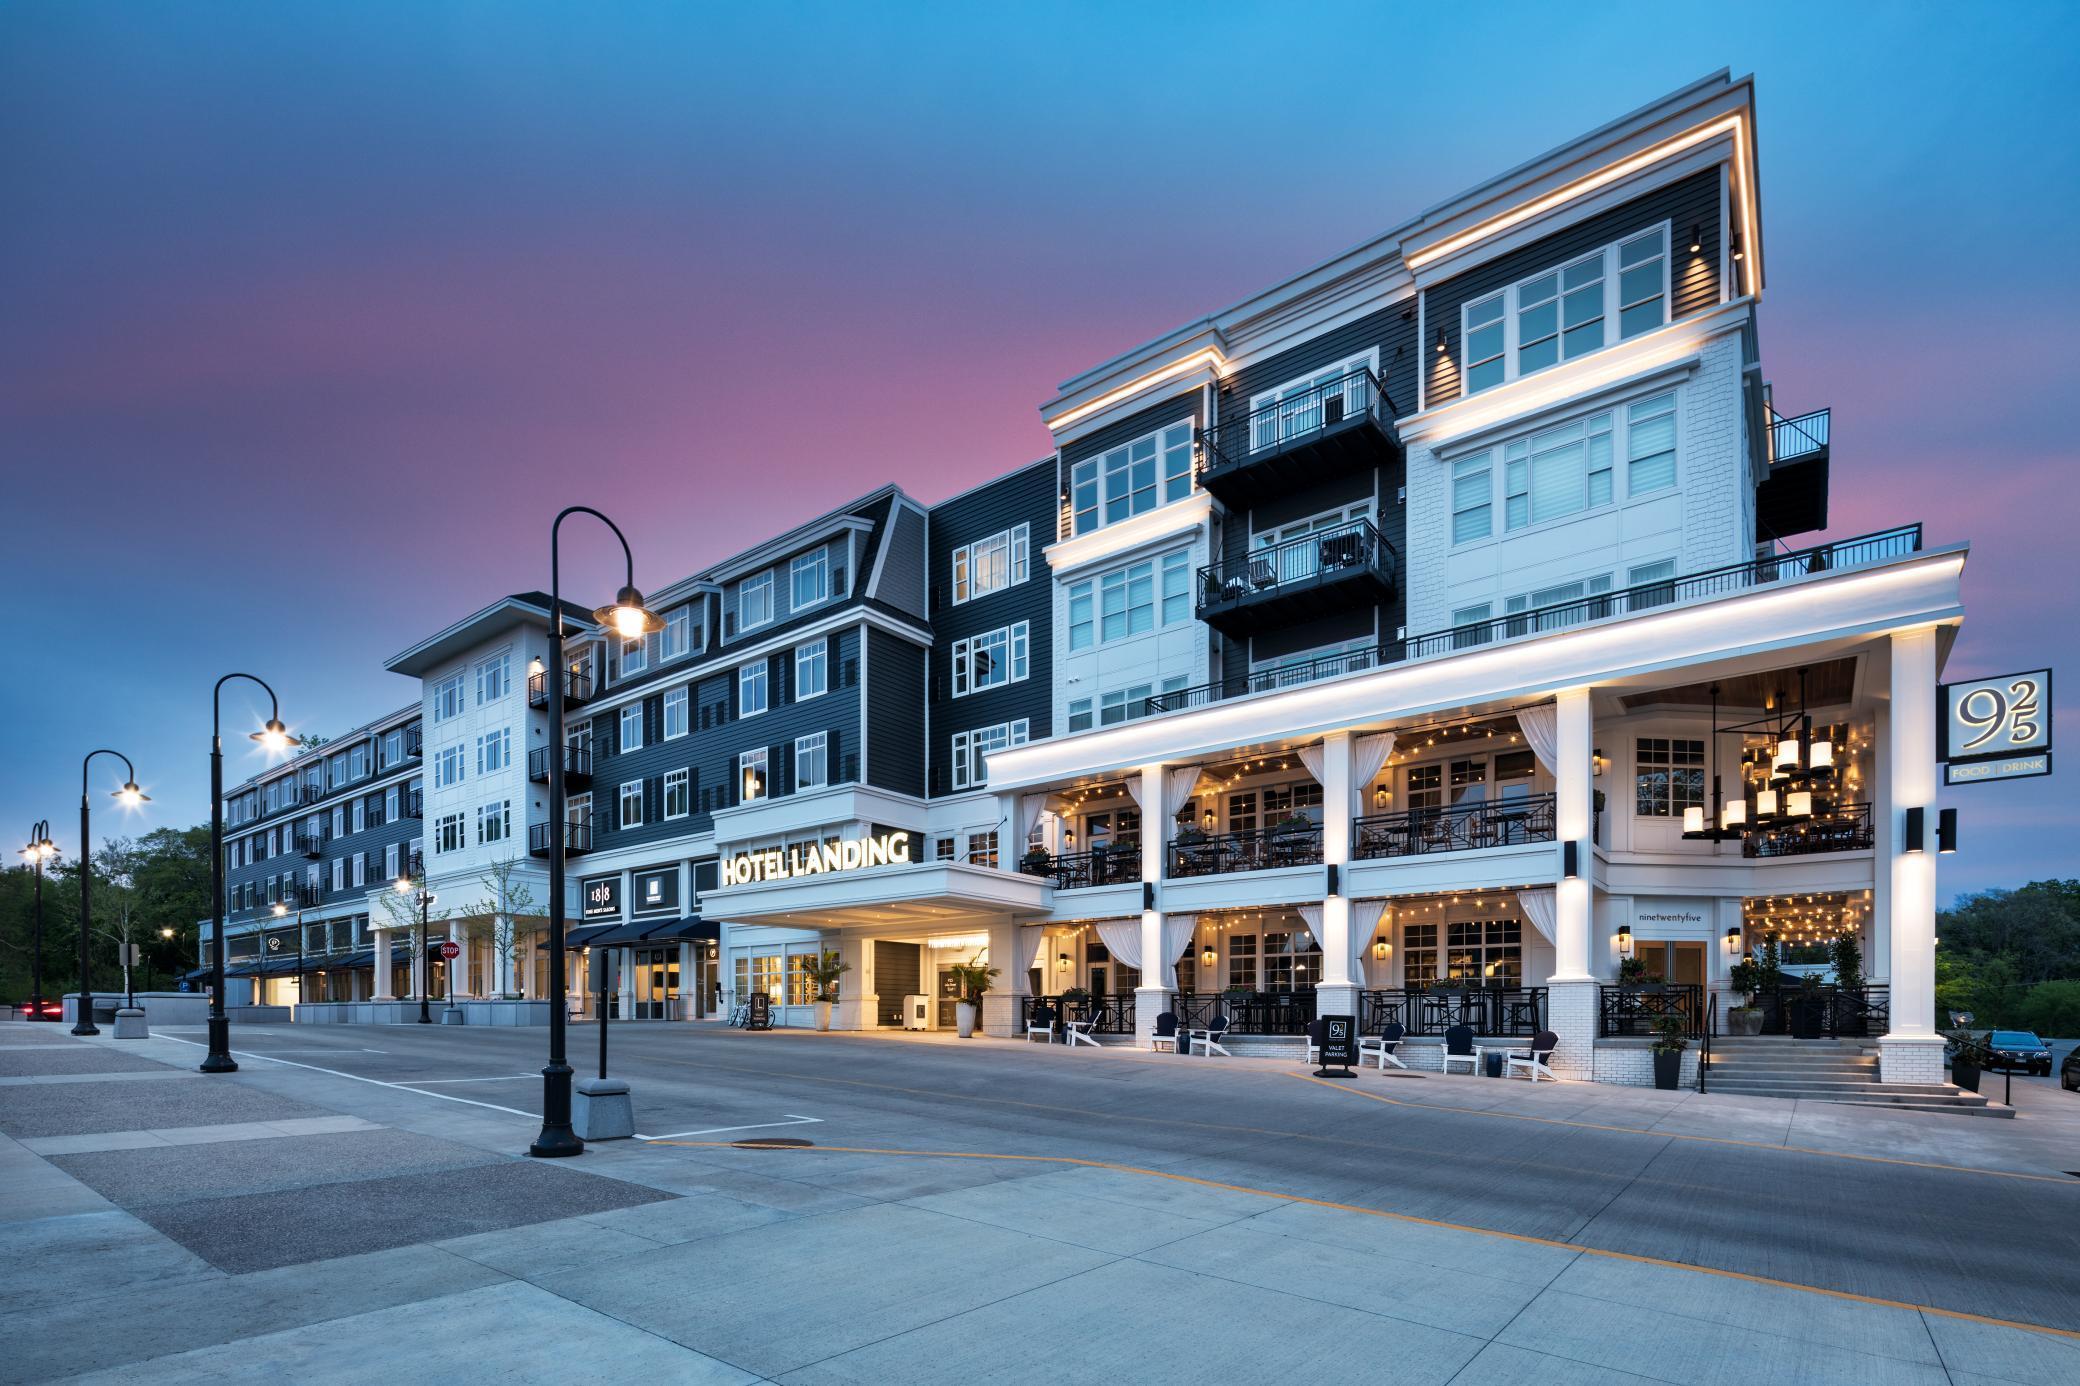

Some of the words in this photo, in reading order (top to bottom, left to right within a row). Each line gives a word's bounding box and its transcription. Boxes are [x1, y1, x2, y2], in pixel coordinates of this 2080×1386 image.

[1952, 766, 1990, 778] FOOD
[2002, 760, 2043, 773] DRINK
[722, 851, 789, 886] HOTEL
[792, 832, 909, 877] LANDING
[1639, 911, 1702, 924] ninetwentyfive
[442, 946, 459, 954] STOP
